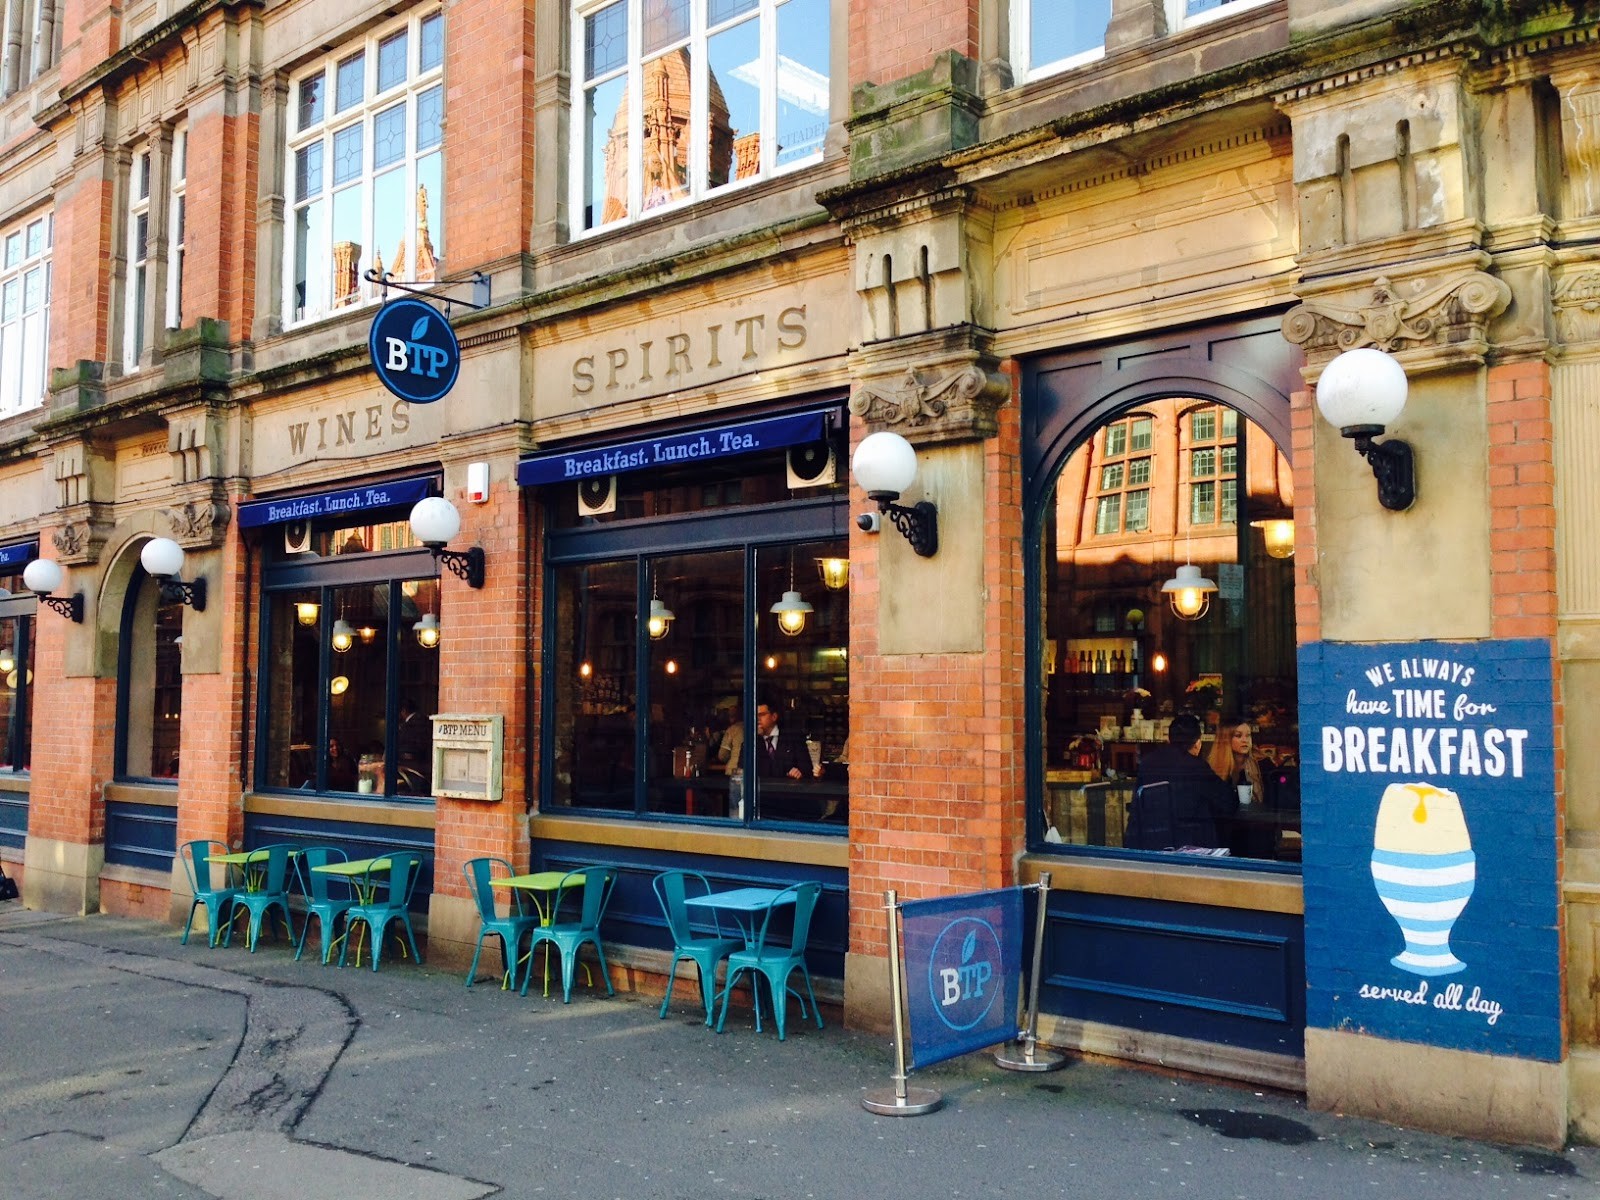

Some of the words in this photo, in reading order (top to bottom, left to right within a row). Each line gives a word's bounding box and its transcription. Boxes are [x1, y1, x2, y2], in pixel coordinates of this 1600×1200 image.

[385, 336, 449, 379] BTP
[572, 304, 808, 397] SPIRITS
[288, 399, 410, 456] WINES
[564, 449, 649, 477] Breakfast.
[653, 437, 716, 463] Lunch.
[719, 431, 760, 452] Tea.
[268, 500, 322, 521] Breakfast.
[324, 492, 364, 512] Lunch.
[365, 489, 391, 505] Tea.
[1364, 661, 1396, 688] WE
[1400, 658, 1475, 687] ALWAYS
[1346, 688, 1391, 715] have
[1392, 689, 1446, 719] TIME
[1453, 693, 1497, 721] for
[443, 724, 459, 735] BTP
[459, 724, 487, 736] MENU
[1321, 725, 1528, 778] BREAKFAST
[939, 960, 992, 1007] BTP
[1358, 980, 1429, 1005] served
[1433, 982, 1464, 1010] all
[1465, 985, 1503, 1026] day
